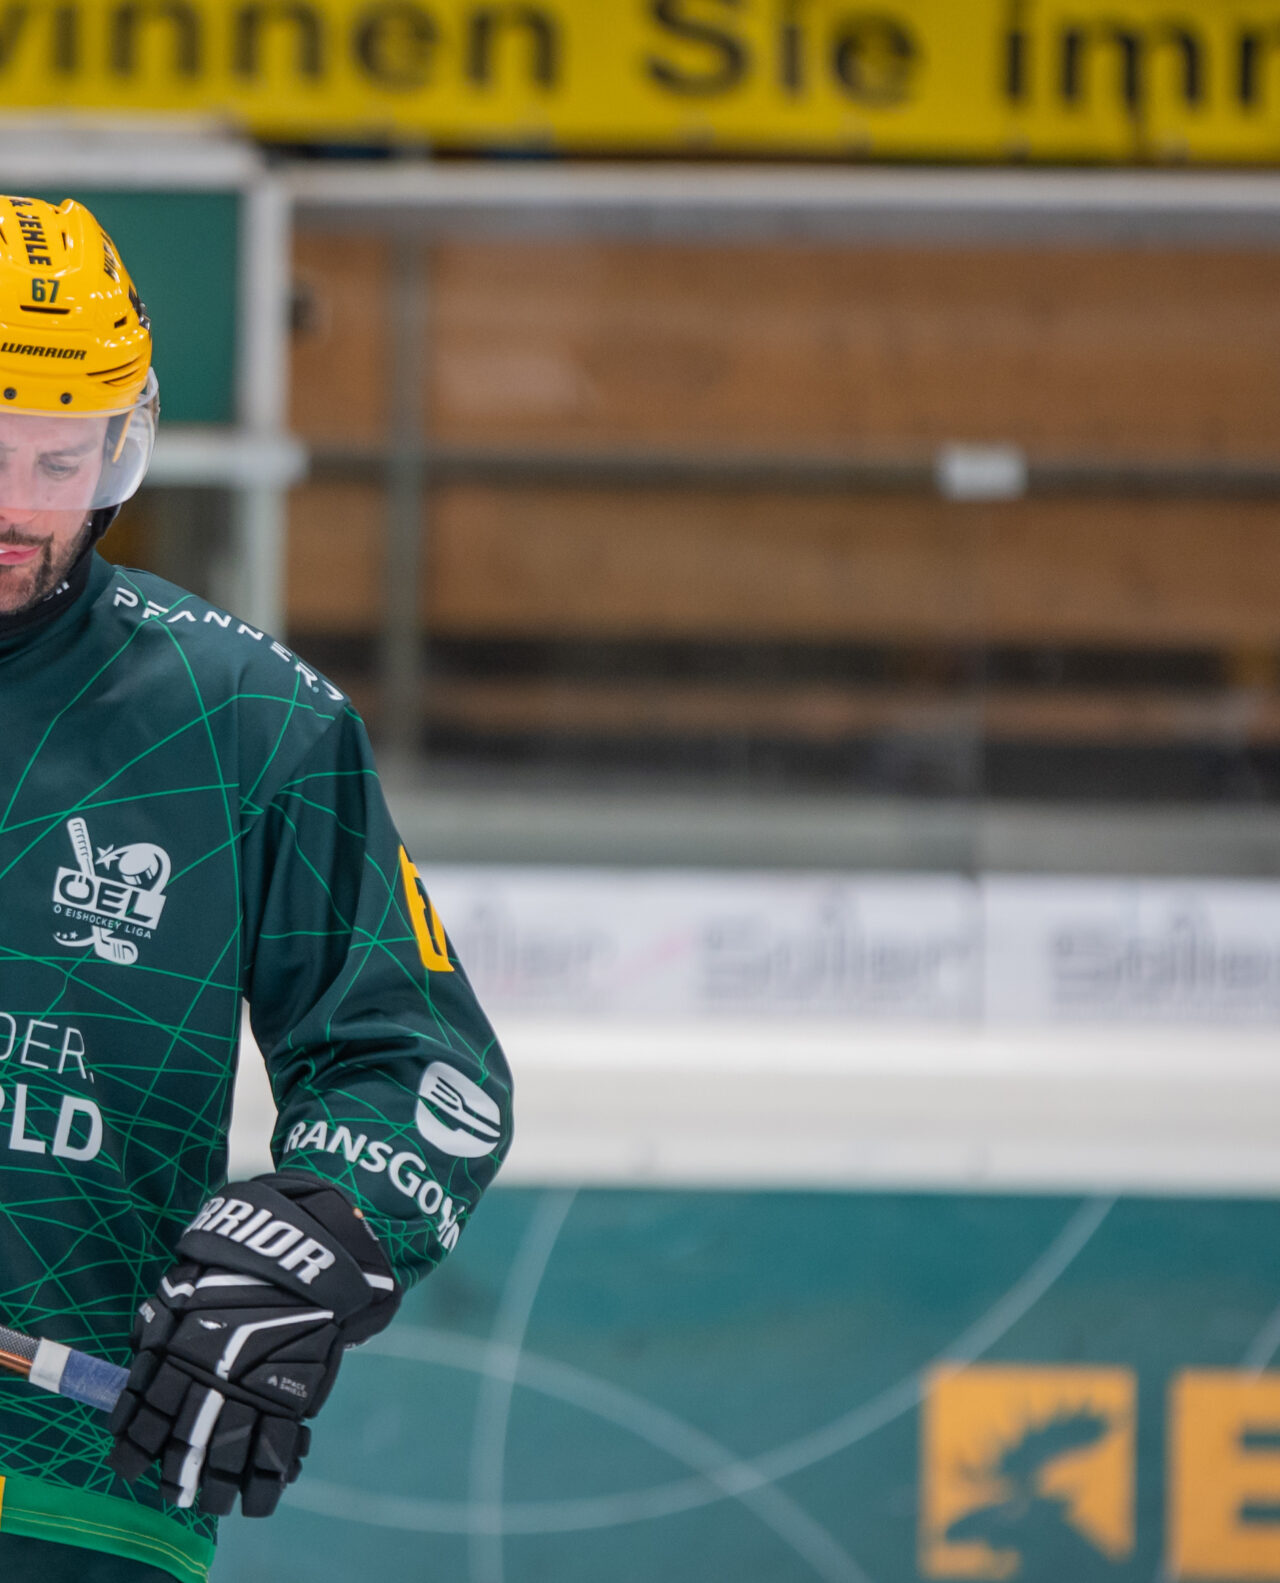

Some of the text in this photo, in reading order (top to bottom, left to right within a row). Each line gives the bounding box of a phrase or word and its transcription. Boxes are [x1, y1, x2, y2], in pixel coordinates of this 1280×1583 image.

[645, 0, 925, 106] Sie
[16, 212, 52, 266] JEHLE
[32, 278, 59, 303] 67
[0, 342, 87, 361] WARRIOR
[65, 908, 122, 930] EISHOCKEY
[125, 925, 152, 939] LIGA
[184, 1197, 336, 1285] RRIOR
[281, 1377, 307, 1391] SPACE
